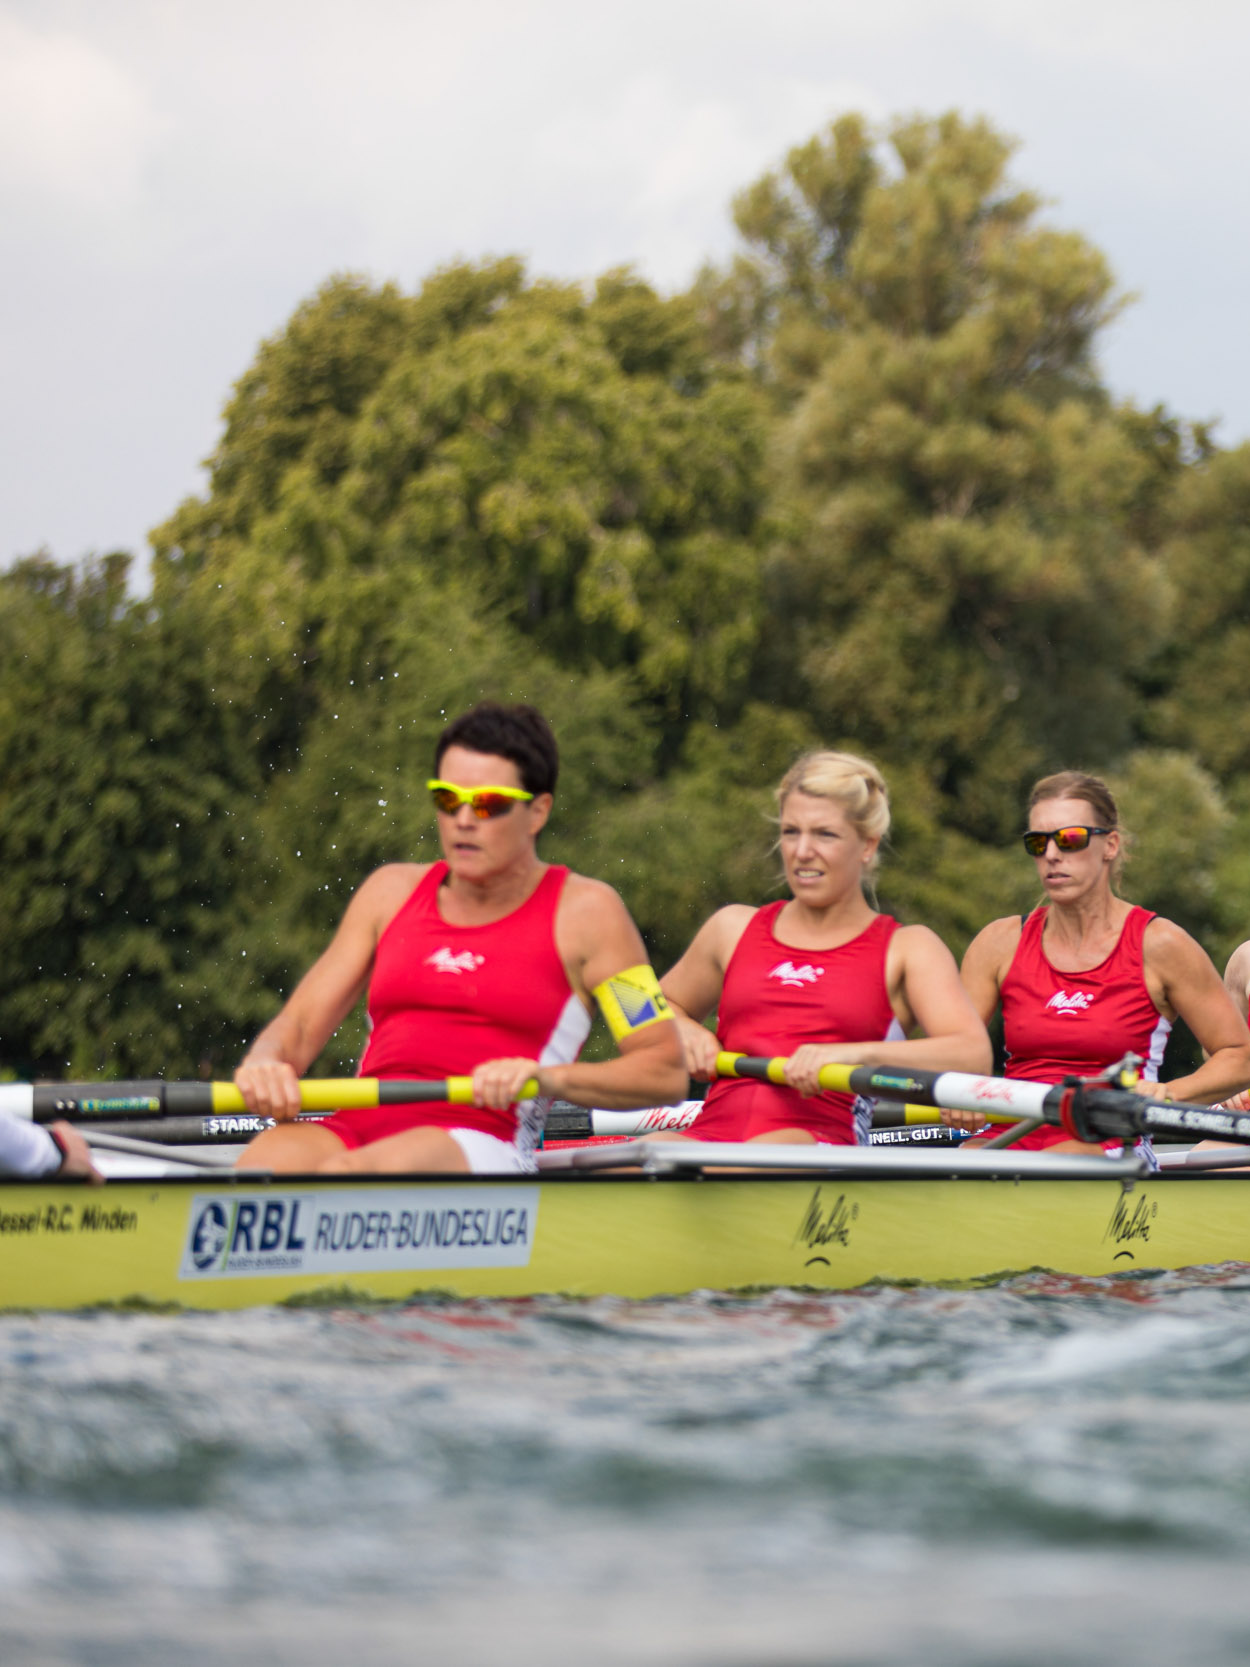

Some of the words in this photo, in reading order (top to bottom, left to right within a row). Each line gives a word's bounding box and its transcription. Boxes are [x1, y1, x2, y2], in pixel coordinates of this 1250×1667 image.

[210, 1117, 265, 1135] STARK.
[868, 1130, 910, 1144] NELL.
[911, 1127, 943, 1140] GUT.
[80, 1204, 138, 1232] Minden
[231, 1200, 305, 1252] RBL
[313, 1207, 528, 1252] RUDER-BUNDESLIGA
